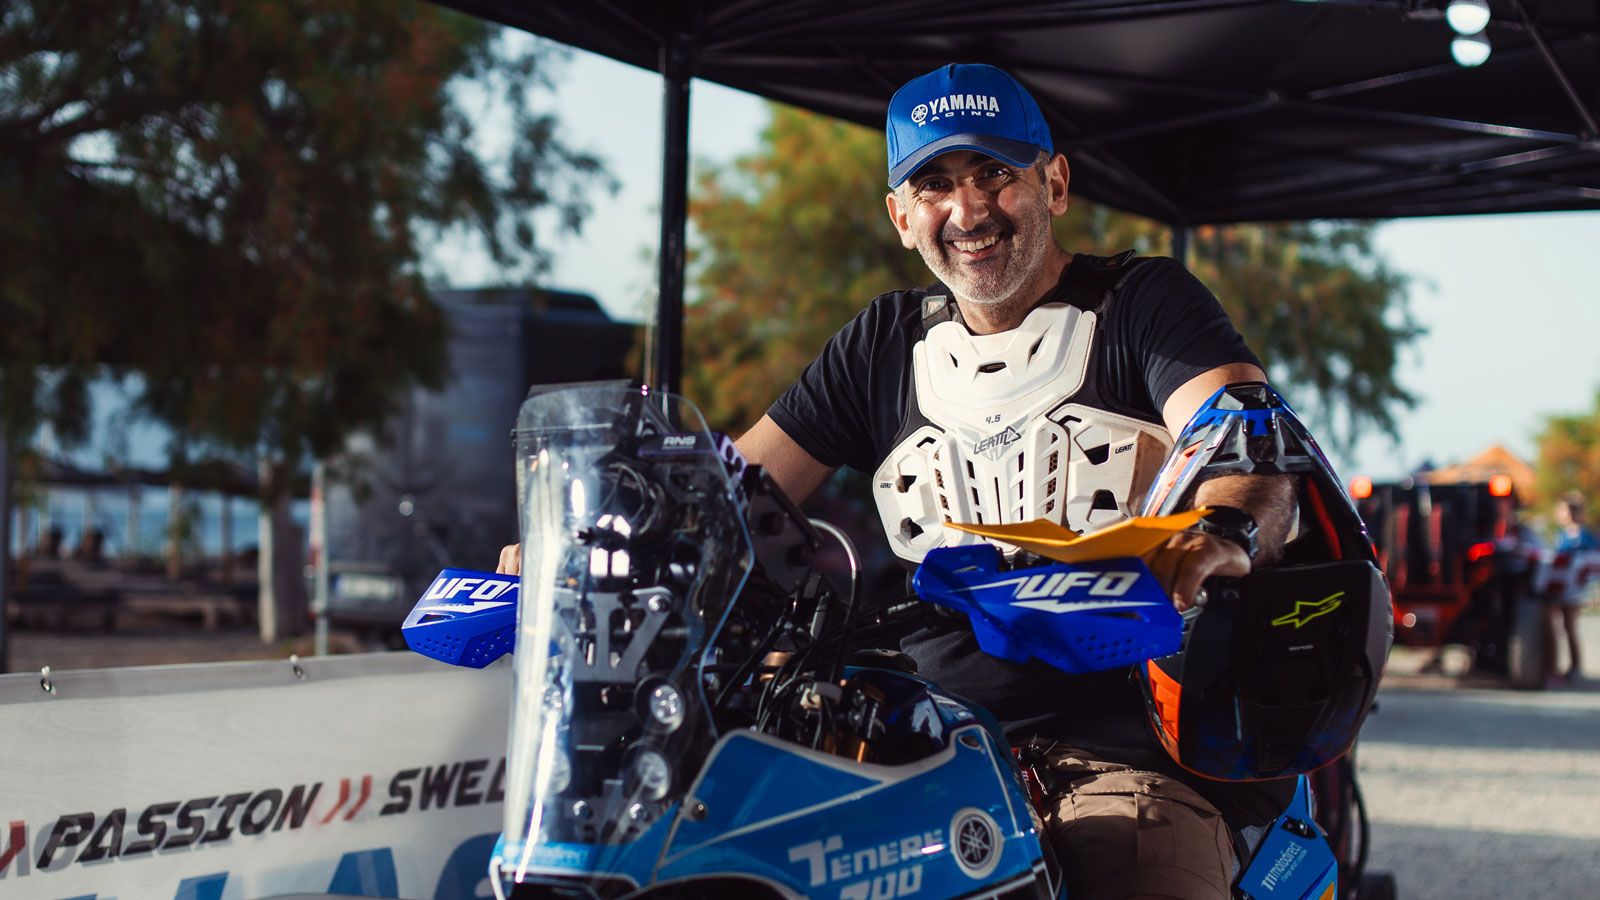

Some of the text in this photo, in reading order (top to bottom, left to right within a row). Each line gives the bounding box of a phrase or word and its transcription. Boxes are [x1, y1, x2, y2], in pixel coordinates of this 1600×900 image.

[929, 94, 1000, 115] YAMAHA
[918, 110, 996, 127] RACING
[985, 414, 1001, 424] 4.5
[973, 429, 1011, 455] LEATT
[1114, 443, 1134, 454] LEATT
[425, 577, 511, 600] UFO
[1015, 571, 1141, 600] UFO
[35, 783, 323, 869] PASSION
